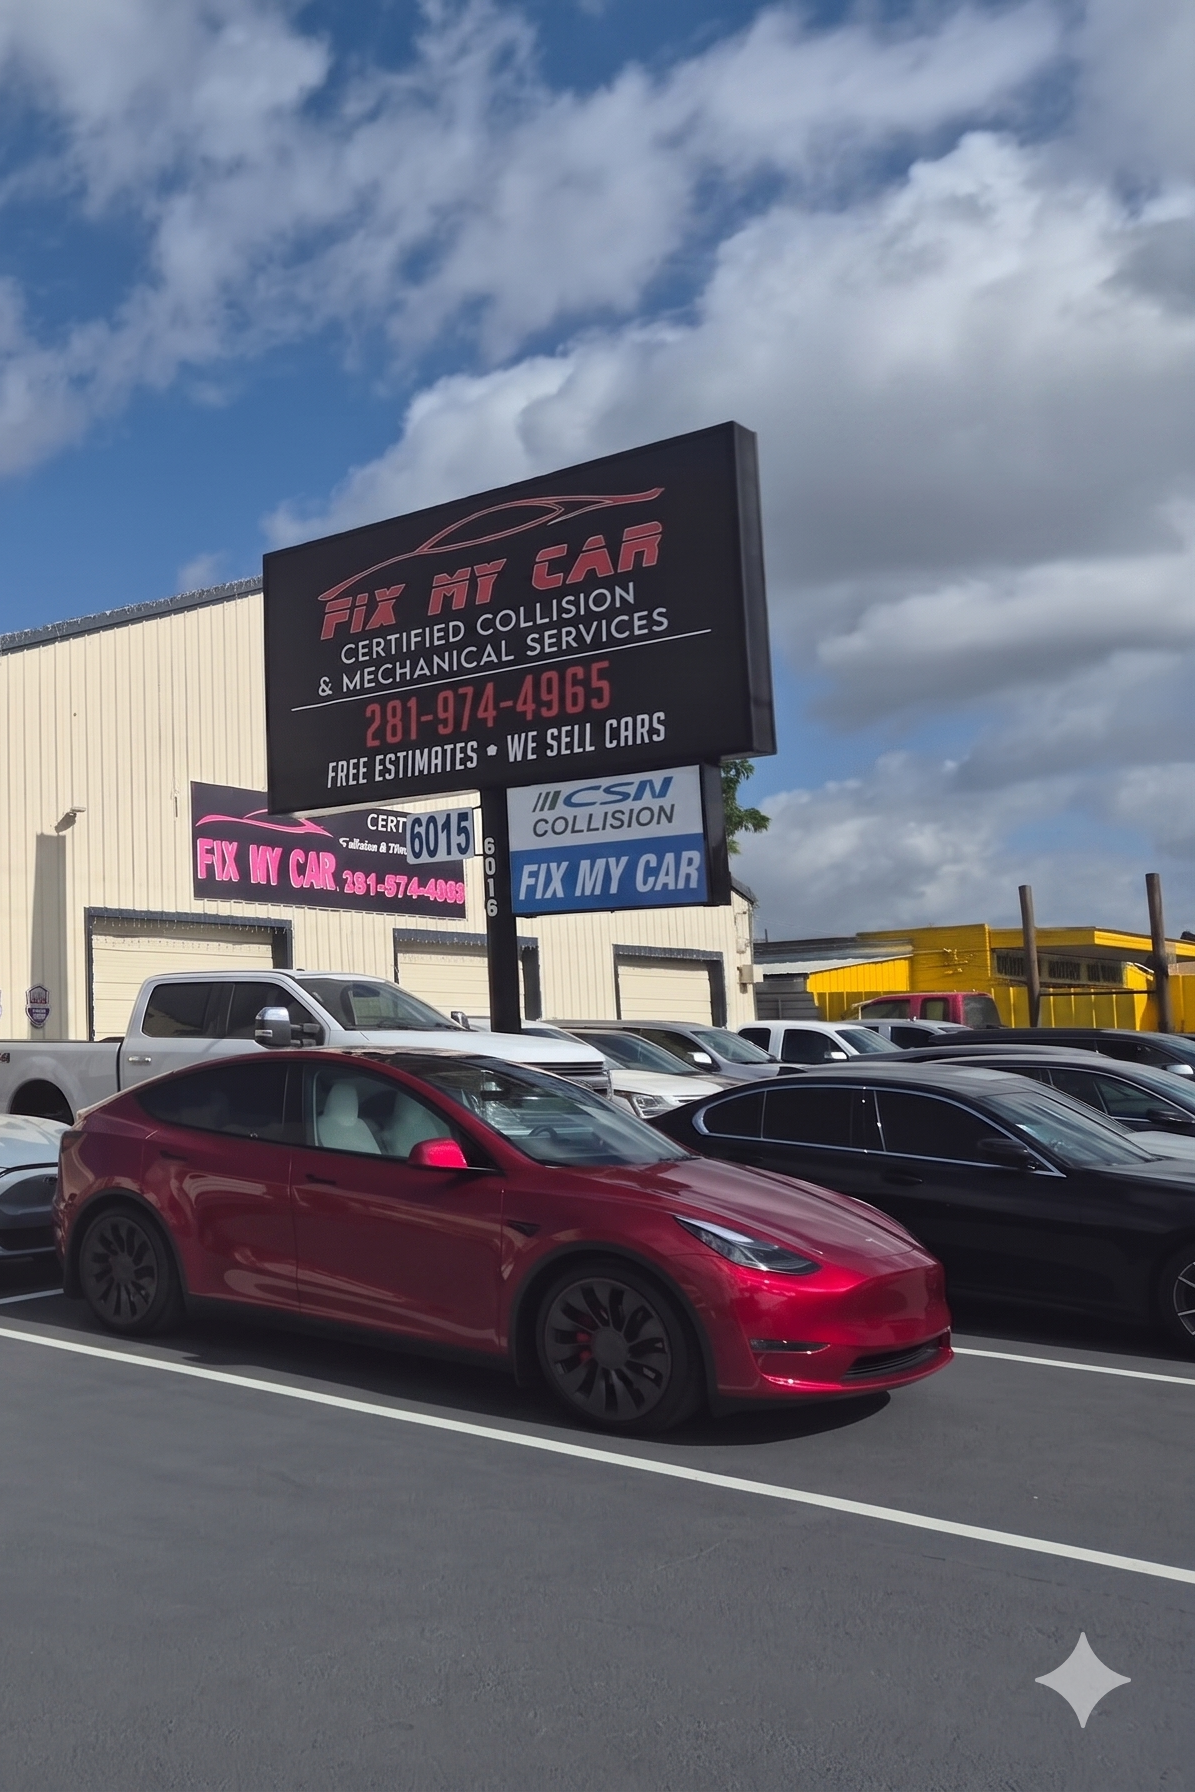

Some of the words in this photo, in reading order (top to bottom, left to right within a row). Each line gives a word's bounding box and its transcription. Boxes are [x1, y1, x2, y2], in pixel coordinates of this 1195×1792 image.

[427, 558, 507, 616] MY
[531, 521, 662, 591] CAR
[318, 676, 333, 698] &
[342, 640, 516, 693] MECHANICAL
[526, 606, 670, 657] SERVICES
[340, 620, 466, 665] CERTIFIED
[476, 581, 635, 637] COLLISION
[365, 661, 611, 748] 281-974-4965
[327, 757, 369, 789] FREE
[374, 740, 479, 782] ESTIMATES
[506, 730, 538, 763] WE
[546, 722, 596, 757] SELL
[605, 711, 666, 749] CARS
[532, 803, 676, 838] COLLISION
[562, 775, 674, 809] CSN
[197, 837, 240, 882] FIX
[409, 811, 471, 860] 6015
[518, 861, 569, 901] FIX
[574, 855, 630, 897] MY
[635, 850, 701, 893] CAR
